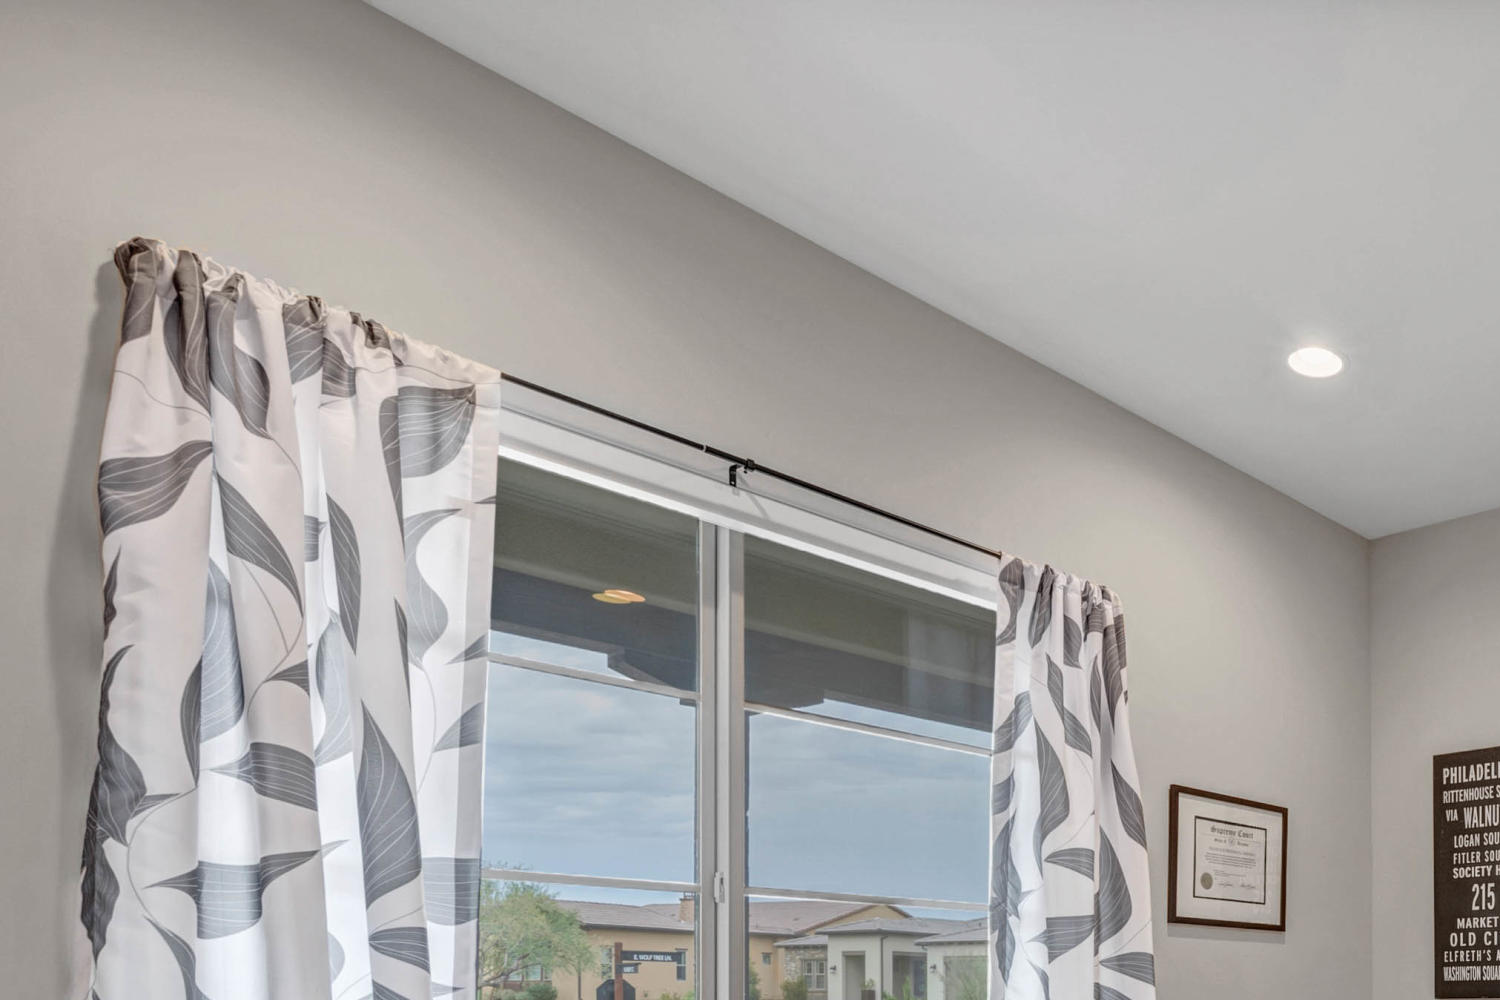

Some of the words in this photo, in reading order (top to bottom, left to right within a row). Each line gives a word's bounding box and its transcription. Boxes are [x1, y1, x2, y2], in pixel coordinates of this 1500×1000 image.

[1443, 785, 1494, 804] RITTENHOUSE
[1445, 809, 1458, 822] VIA
[1454, 833, 1480, 848] LOGAN
[1453, 851, 1480, 865] FITLER
[1453, 865, 1492, 879] SOCIETY
[1472, 883, 1495, 911] 215
[1457, 916, 1499, 929] MARKET
[1449, 932, 1476, 947] OLD
[1444, 949, 1492, 962] ELFRETH'S
[1443, 965, 1481, 981] WASHINGTON
